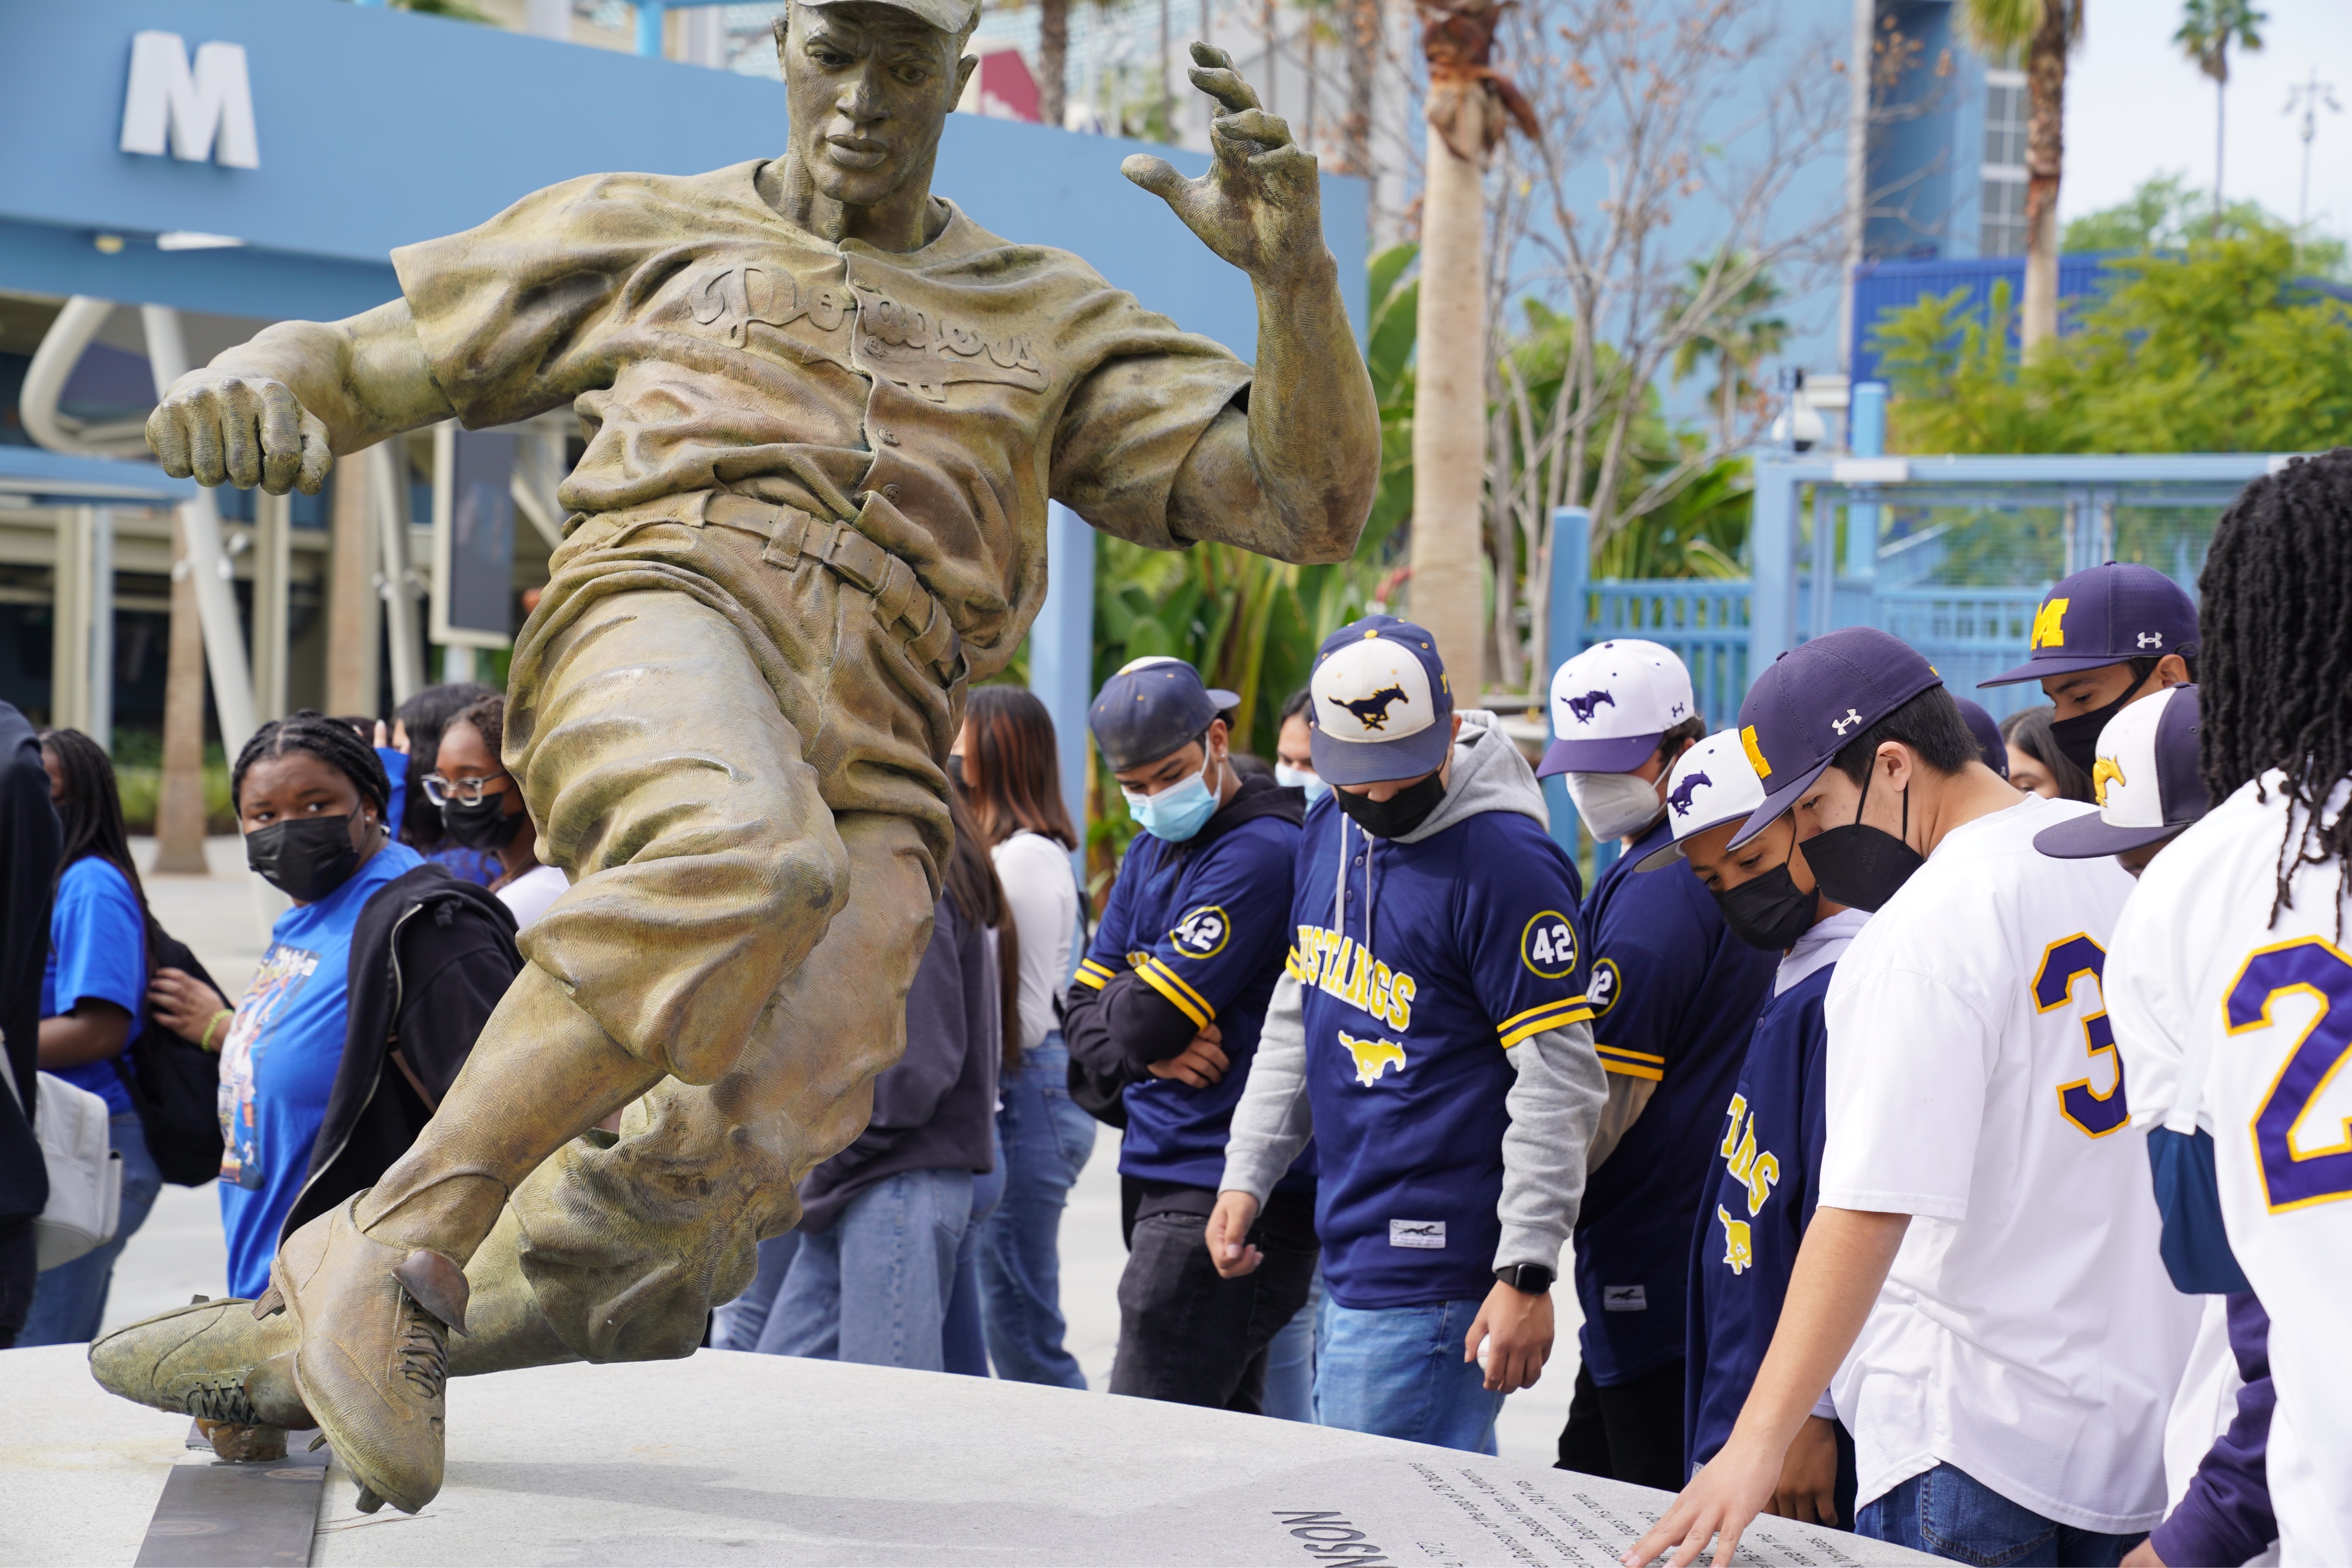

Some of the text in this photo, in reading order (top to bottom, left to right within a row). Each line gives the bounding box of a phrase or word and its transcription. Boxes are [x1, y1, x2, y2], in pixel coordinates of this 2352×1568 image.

[119, 29, 260, 170] M
[2030, 597, 2070, 652] M
[1175, 915, 1223, 951] 42
[1532, 924, 1574, 964] 42
[2221, 934, 2352, 1216] 2
[1512, 1480, 1536, 1491] was
[1453, 1500, 1481, 1512] age
[1519, 1491, 1557, 1505] 1947
[1465, 1511, 1492, 1522] the
[1591, 1510, 1618, 1519] his
[1505, 1513, 1555, 1537] Baseball
[1557, 1514, 1603, 1540] Robinson
[1607, 1520, 1641, 1536] bears
[1756, 1533, 1781, 1543] the
[1416, 1541, 1458, 1557] 1972
[1544, 1539, 1585, 1561] League
[1783, 1552, 1818, 1567] once
